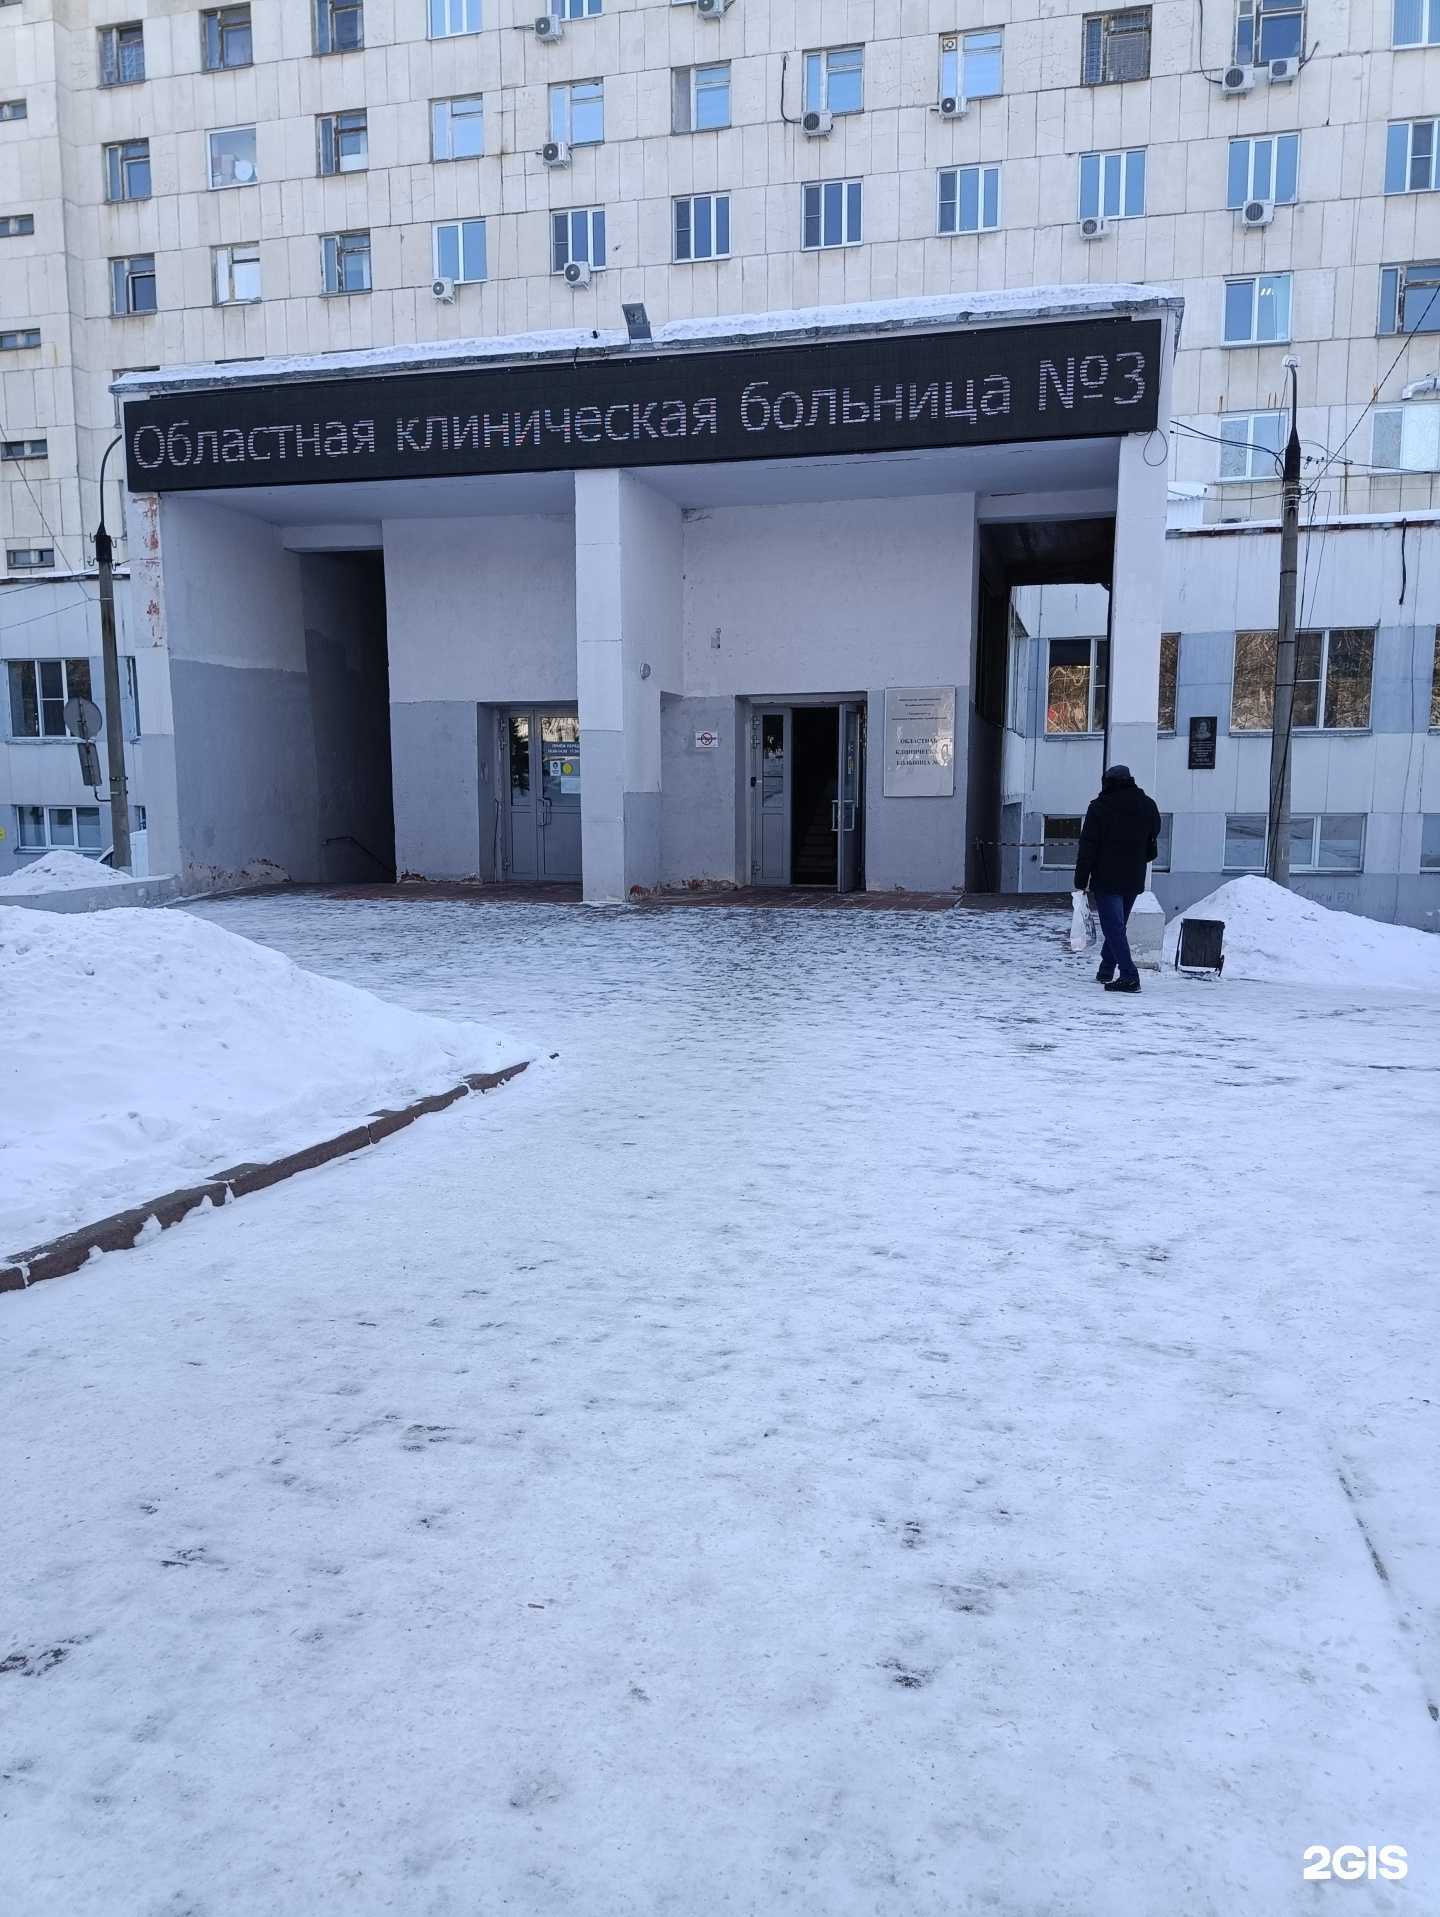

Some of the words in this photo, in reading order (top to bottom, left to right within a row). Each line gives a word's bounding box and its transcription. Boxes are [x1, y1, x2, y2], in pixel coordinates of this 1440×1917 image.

[133, 420, 376, 469] Областная
[396, 397, 717, 452] клиническая
[740, 375, 1011, 432] больница
[1039, 351, 1146, 411] №3
